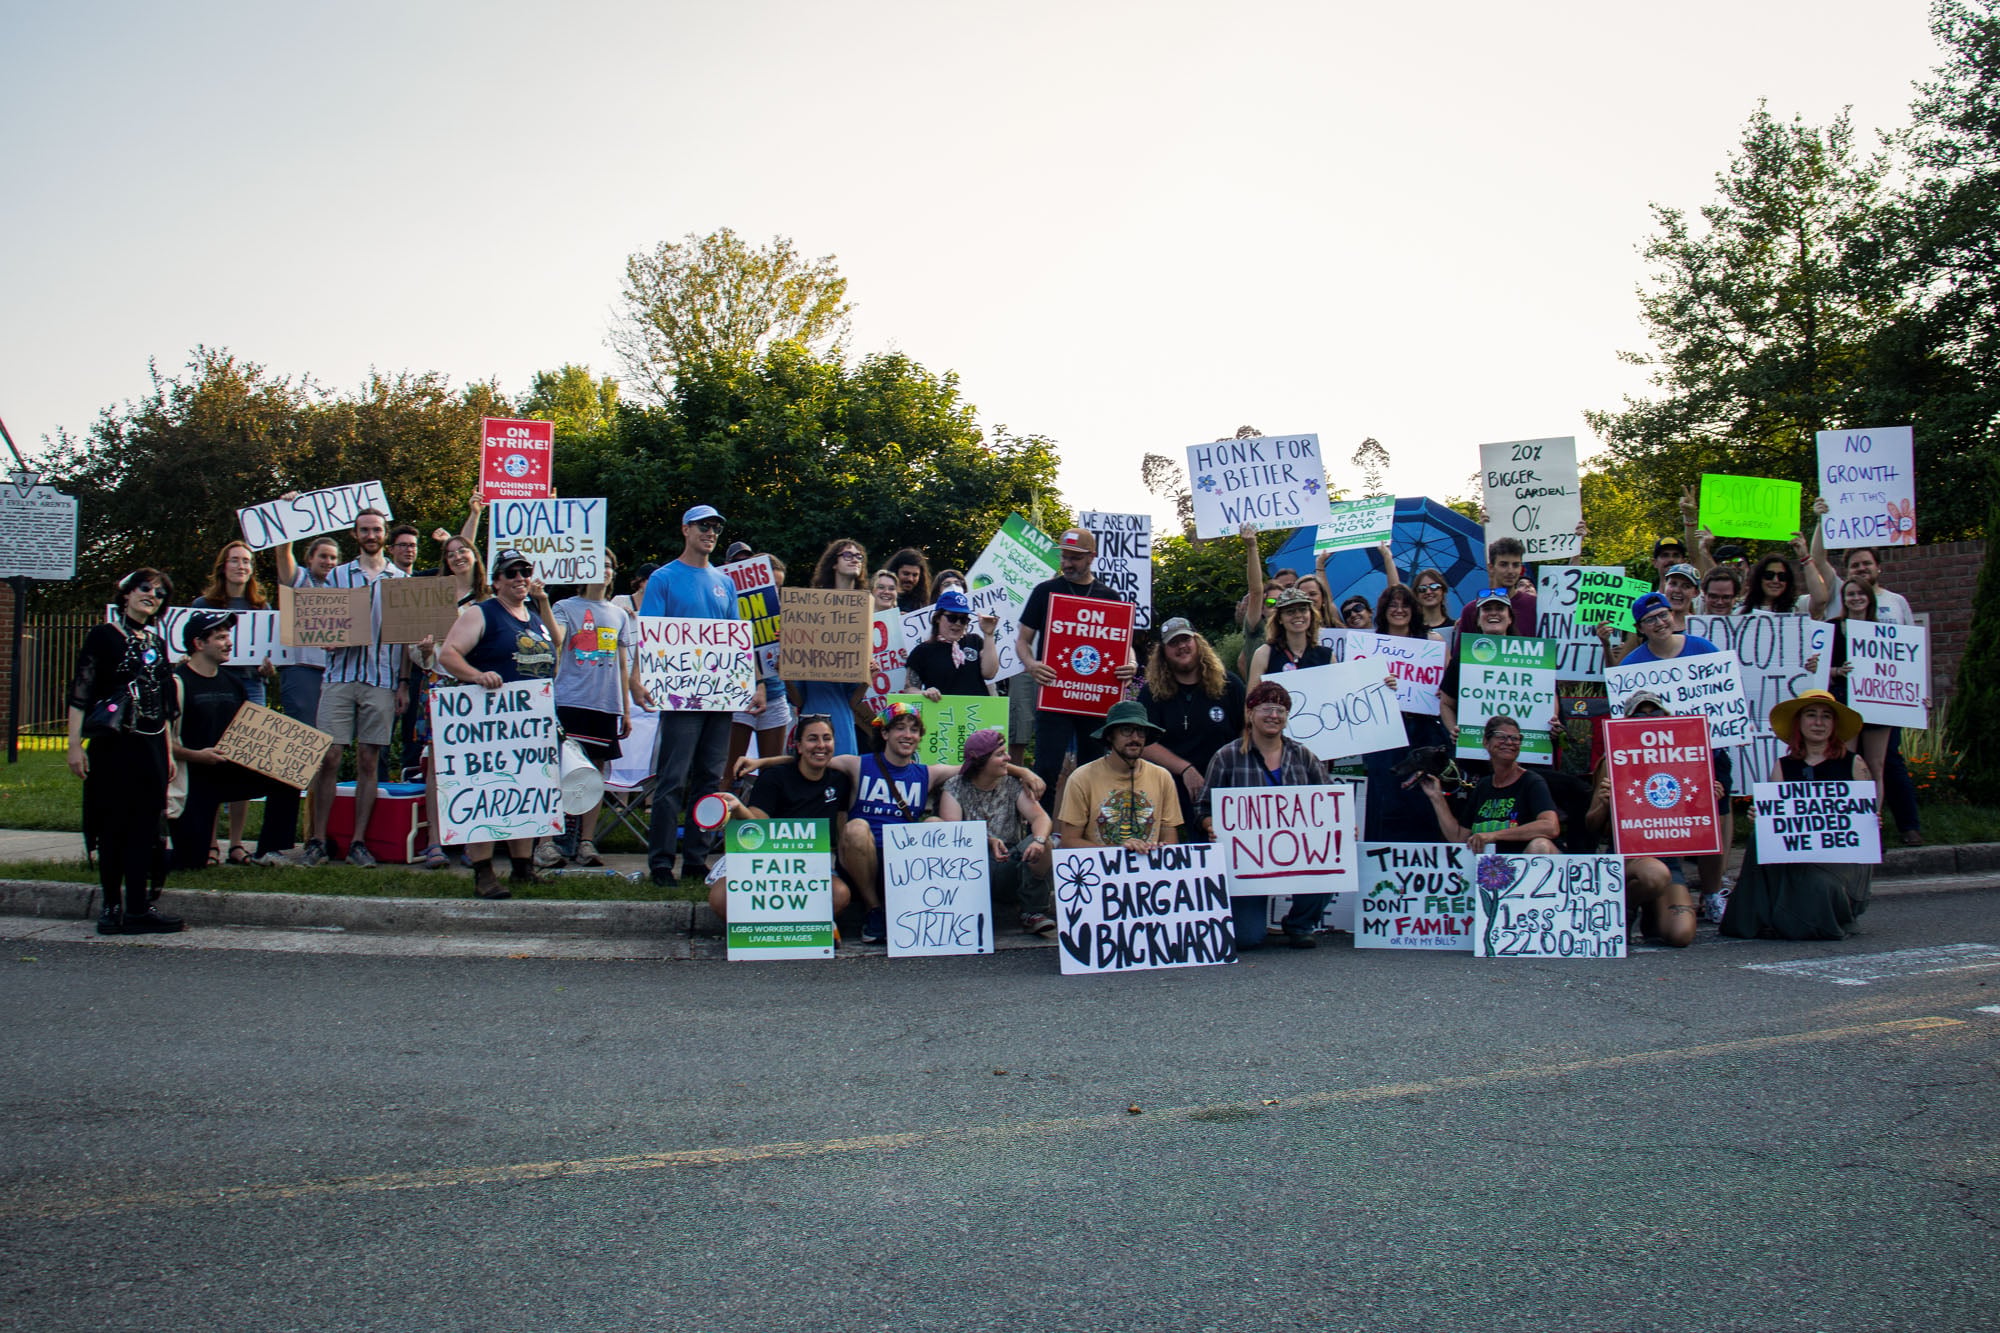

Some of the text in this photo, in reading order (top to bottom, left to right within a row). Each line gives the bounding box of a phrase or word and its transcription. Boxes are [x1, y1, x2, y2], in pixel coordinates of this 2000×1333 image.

[506, 427, 530, 438] ON
[486, 437, 549, 450] STRIKE!
[1512, 444, 1542, 461] 20%
[1845, 434, 1872, 453] NO
[1196, 439, 1314, 471] HONK FOR
[1223, 463, 1299, 491] BETTER
[1488, 470, 1542, 488] BIGGER
[1827, 464, 1900, 484] GROWTH
[485, 481, 547, 491] MACHINISTS
[499, 488, 532, 497] UNION
[1220, 490, 1300, 524] WAGES
[1353, 497, 1386, 507] IAM
[1709, 480, 1798, 519] BOYCOTT
[1840, 491, 1887, 504] AT THIS
[241, 482, 389, 549] ON STRIKE
[494, 500, 598, 538] LOYALTY
[1083, 514, 1143, 531] WE ARE ON
[1319, 515, 1392, 529] CONTRACT
[1337, 510, 1377, 520] FAIR
[1512, 505, 1541, 532] 0%
[1335, 522, 1375, 533] NOW
[1824, 514, 1900, 540] GARDEN
[513, 536, 575, 553] EQUALS
[1020, 524, 1054, 553] IAM
[1092, 531, 1149, 558] TRIKE
[539, 555, 597, 583] wages
[1098, 558, 1129, 572] OVER
[1582, 573, 1649, 594] HOLD THE
[296, 595, 348, 606] EVERYONE
[389, 586, 455, 608] LIVING
[738, 592, 768, 620] ON
[783, 591, 867, 607] LEWIS GINTER:
[1579, 591, 1635, 609] PICKET
[296, 607, 347, 618] DESERVES
[782, 608, 860, 625] TAKING THE
[1077, 609, 1105, 624] ON
[1581, 609, 1625, 626] LINE!
[305, 618, 352, 630] LIVING
[1051, 620, 1127, 642] STRIKE!
[1875, 624, 1897, 639] NO
[299, 630, 346, 643] WAGE
[640, 621, 751, 650] WORKERS
[821, 632, 848, 644] OUT
[848, 632, 865, 644] OF
[1372, 638, 1415, 659] Fair
[1501, 639, 1544, 657] IAM
[1852, 637, 1919, 662] MONEY
[641, 652, 753, 673] MAKE OUR
[782, 648, 860, 669] NONPROFIT!
[1503, 657, 1541, 665] UNION
[1483, 670, 1533, 687] FAIR
[1688, 661, 1732, 681] SPENT
[1875, 662, 1897, 678] NO
[644, 675, 698, 701] GARDEN
[1047, 680, 1119, 694] MACHINISTS
[1063, 690, 1101, 702] UNION
[1460, 687, 1554, 704] CONTRACT
[1677, 678, 1735, 701] BUSTING
[1851, 676, 1920, 702] WORKERS!
[439, 690, 532, 717] NO FAIR
[1480, 702, 1533, 718] NOW
[1704, 697, 1745, 717] PAY US
[241, 707, 333, 752] IT PROBABLY
[443, 717, 553, 745] CONTRACT?
[1640, 730, 1675, 746] ON
[1709, 716, 1749, 740] AGE?
[222, 732, 306, 773] CHEAPER JUST
[929, 731, 938, 754] TOO
[233, 749, 256, 765] PAY
[257, 759, 272, 772] US
[284, 742, 321, 765] BEEN
[444, 747, 559, 776] I BEG YOUR
[1613, 746, 1706, 765] STRIKE!
[859, 775, 921, 807] IAM
[1778, 781, 1850, 800] UNITED
[448, 788, 562, 824] GARDEN?
[1221, 792, 1346, 831] CONTRACT
[1756, 798, 1877, 816] WE BARGAIN
[768, 822, 816, 840] IAM
[1621, 816, 1712, 829] MACHINISTS
[1773, 814, 1852, 834] DIVIDED
[891, 825, 974, 850] We are the
[1643, 828, 1691, 840] UNION
[1782, 831, 1860, 851] WE BEG
[1232, 829, 1342, 869] NOW!
[1366, 846, 1464, 872] THANK
[752, 859, 806, 874] FAIR
[1099, 845, 1212, 875] WE WON'T
[889, 857, 984, 887] WORKERS
[727, 880, 830, 892] CONTRACT
[1499, 856, 1623, 912] 22 years
[752, 894, 808, 910] NOW
[923, 886, 960, 907] ON
[1101, 874, 1229, 921] BARGAIN
[1424, 896, 1476, 914] FEED
[1500, 896, 1624, 934] Less than
[755, 925, 794, 933] WORKERS
[894, 908, 985, 953] STRIKE!
[1363, 917, 1390, 937] MY
[784, 934, 813, 942] WAGES
[1096, 916, 1238, 969] BACKWARDS
[1404, 937, 1418, 946] PAY
[1420, 937, 1433, 946] MY
